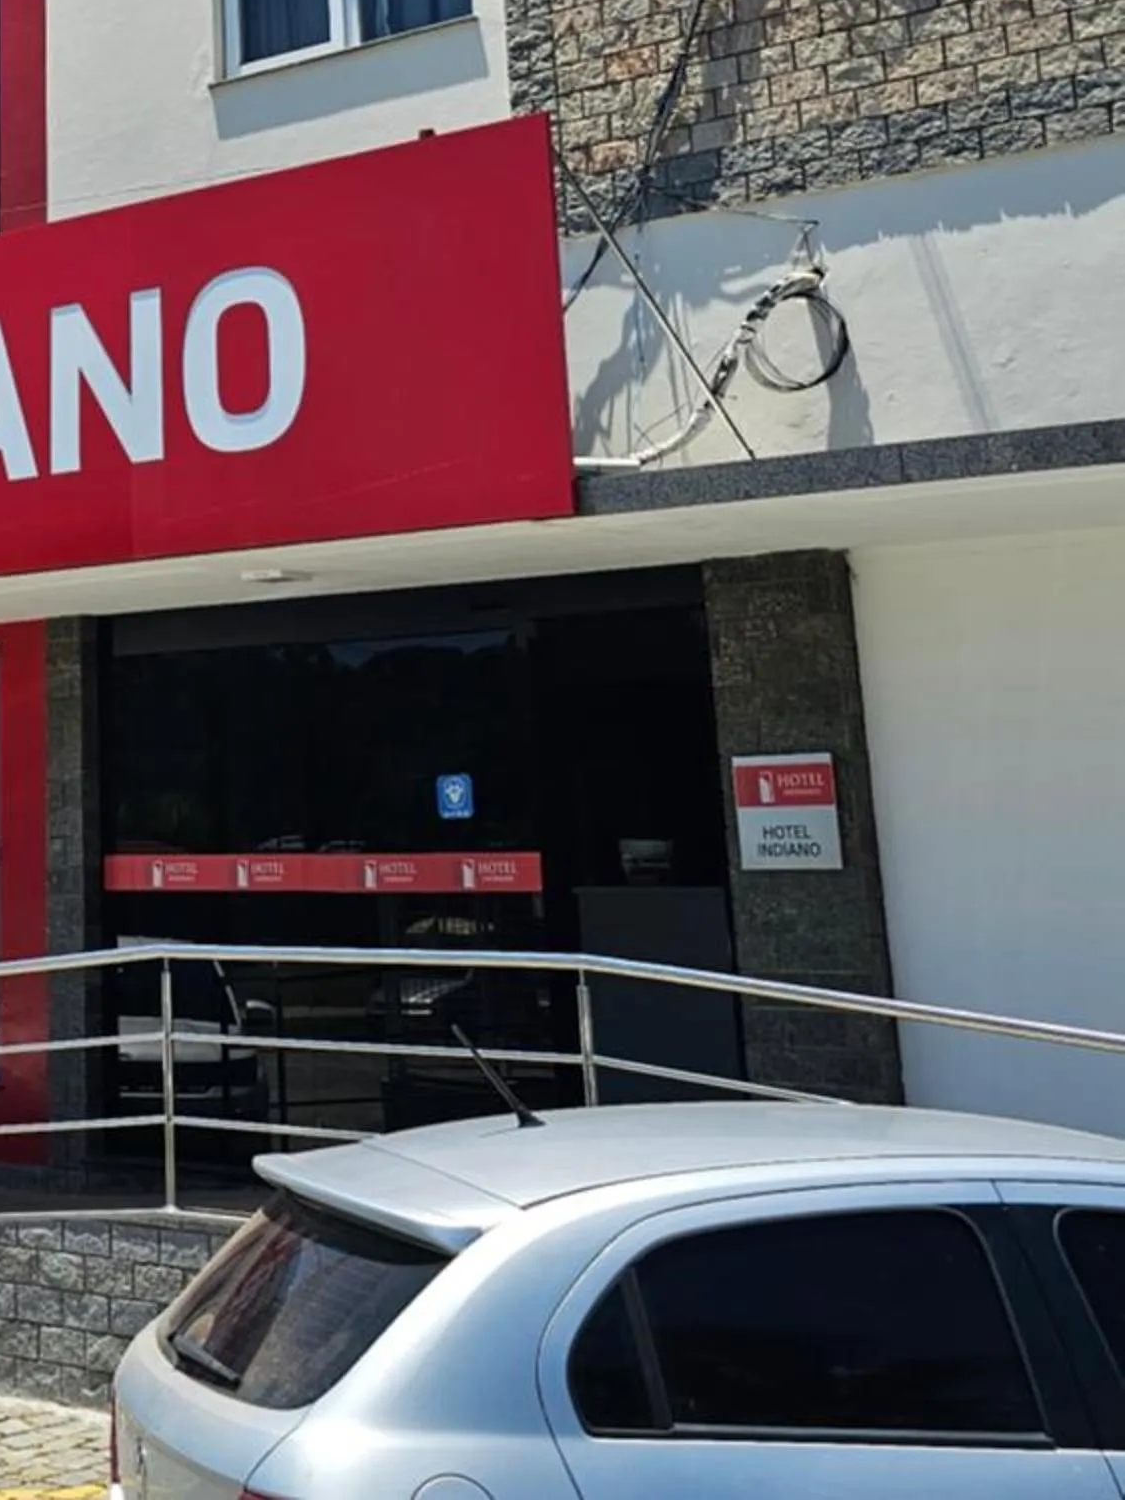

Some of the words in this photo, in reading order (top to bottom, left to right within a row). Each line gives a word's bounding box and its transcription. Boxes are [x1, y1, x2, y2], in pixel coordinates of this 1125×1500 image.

[776, 771, 826, 788] HOTEL
[761, 823, 812, 840] HOTEL
[757, 841, 822, 858] INDIANO
[378, 861, 418, 876] HOTEL
[477, 860, 517, 875] HOTEL
